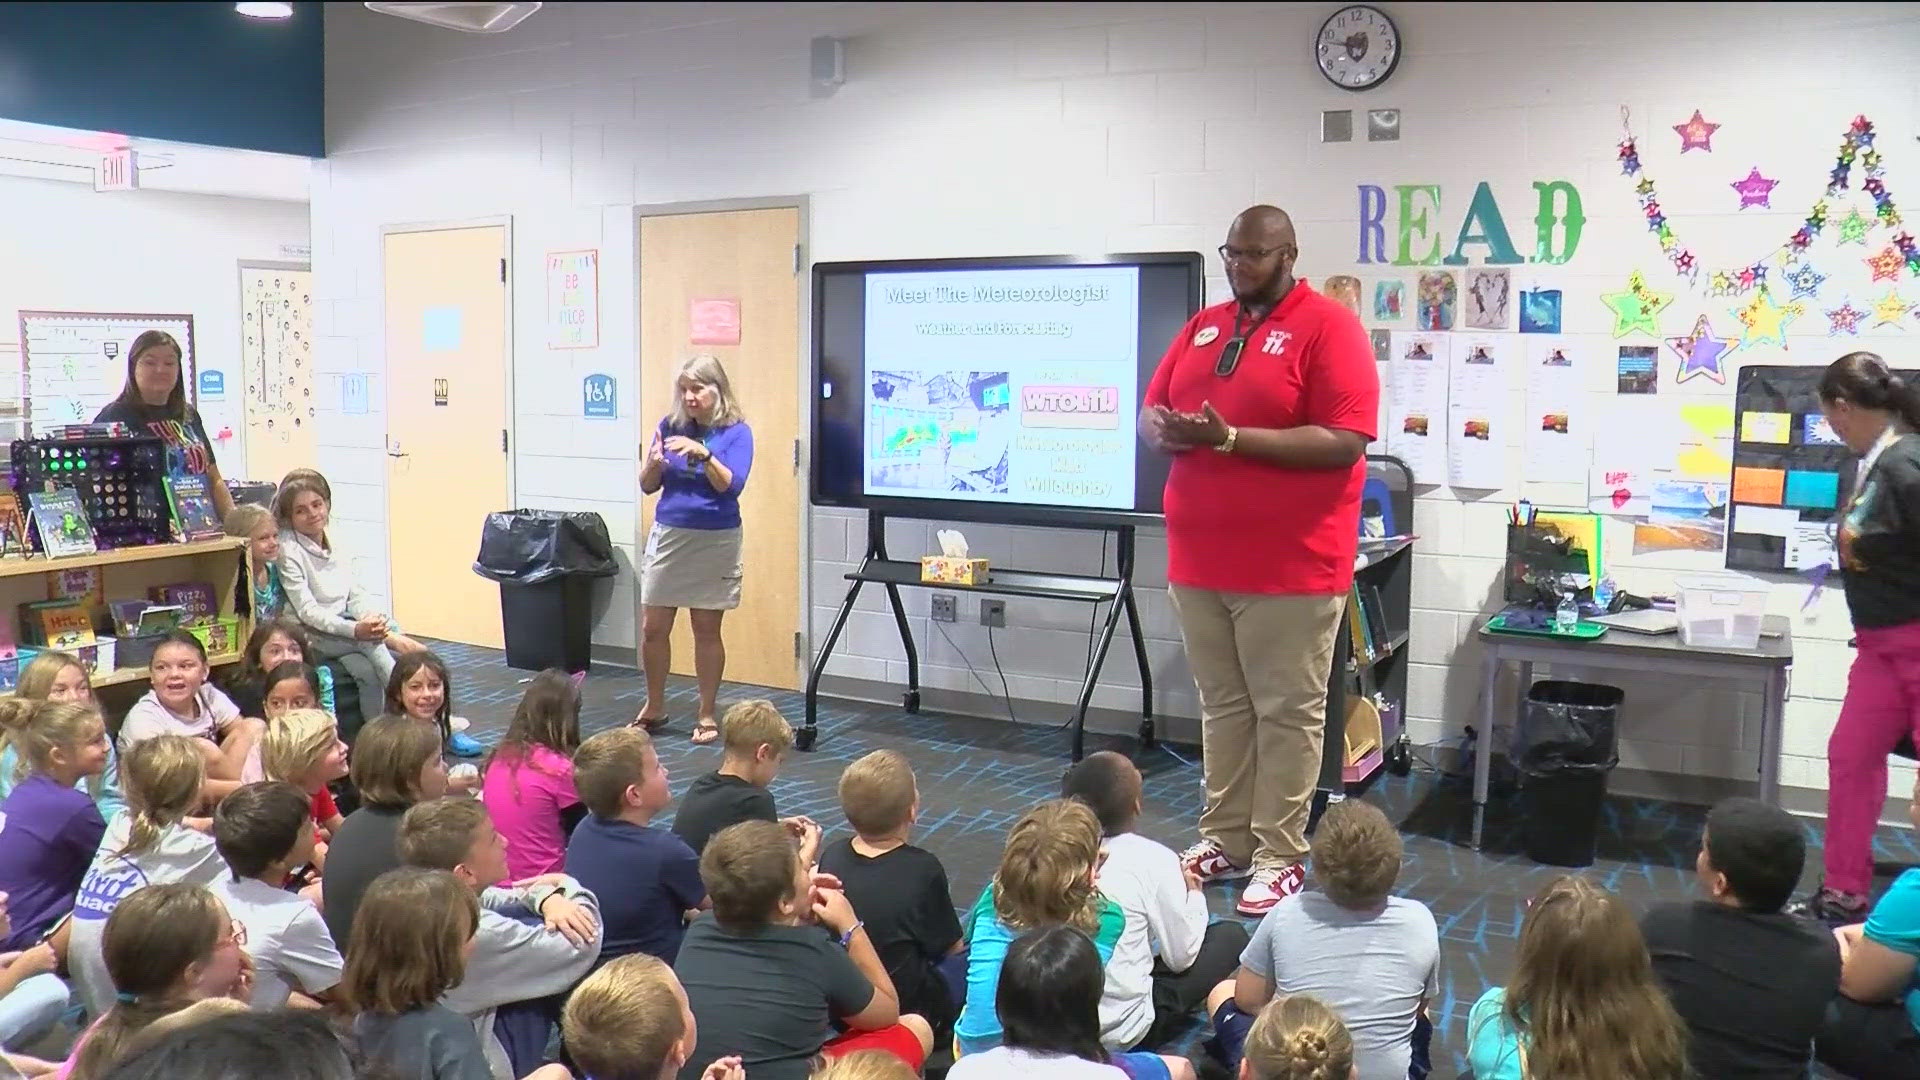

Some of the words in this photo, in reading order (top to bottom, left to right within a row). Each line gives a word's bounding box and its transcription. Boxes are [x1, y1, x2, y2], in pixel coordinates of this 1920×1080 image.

[1351, 10, 1362, 21] 12
[1369, 15, 1374, 24] 1
[1338, 17, 1345, 28] 11
[1325, 30, 1335, 40] 10
[1380, 24, 1387, 36] 2
[1321, 45, 1328, 56] 9
[1384, 40, 1392, 50] 3
[1327, 60, 1333, 70] 8
[1380, 56, 1387, 65] 4
[1339, 71, 1346, 81] 7
[1369, 68, 1376, 79] 5
[102, 156, 124, 185] EXIT
[1356, 180, 1586, 266] READ
[885, 287, 931, 304] Meet
[934, 285, 970, 303] The
[973, 284, 1110, 306] Meteorologist
[915, 321, 970, 336] Weather
[972, 321, 998, 336] and
[999, 321, 1073, 338] Forecasting
